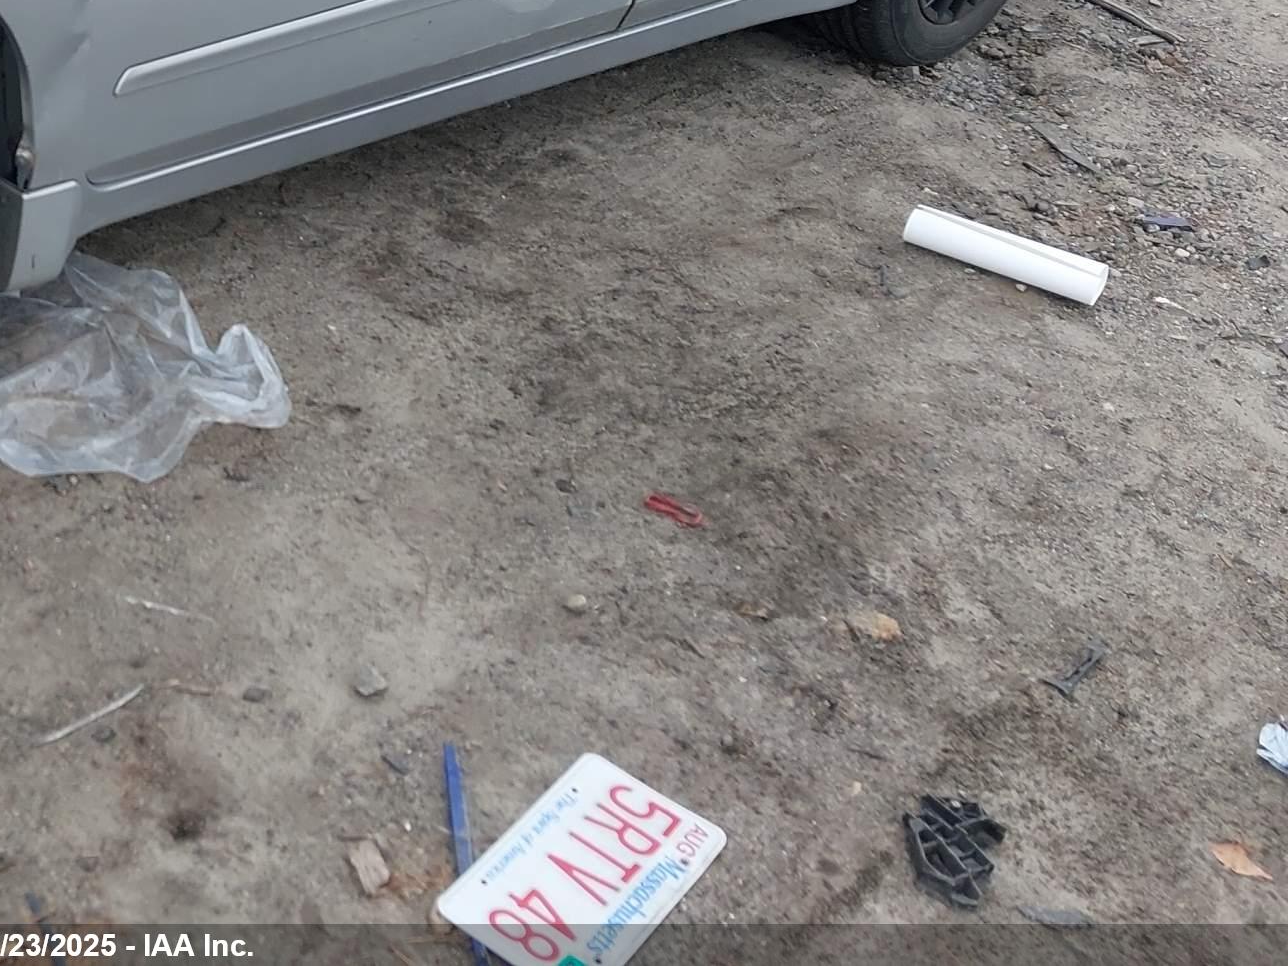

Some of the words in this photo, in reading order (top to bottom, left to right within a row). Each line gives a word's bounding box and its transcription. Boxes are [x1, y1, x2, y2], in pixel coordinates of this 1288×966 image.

[546, 784, 682, 907] 5RTV
[675, 823, 710, 858] AUG
[488, 888, 578, 962] 48
[585, 854, 691, 957] Massachusetts
